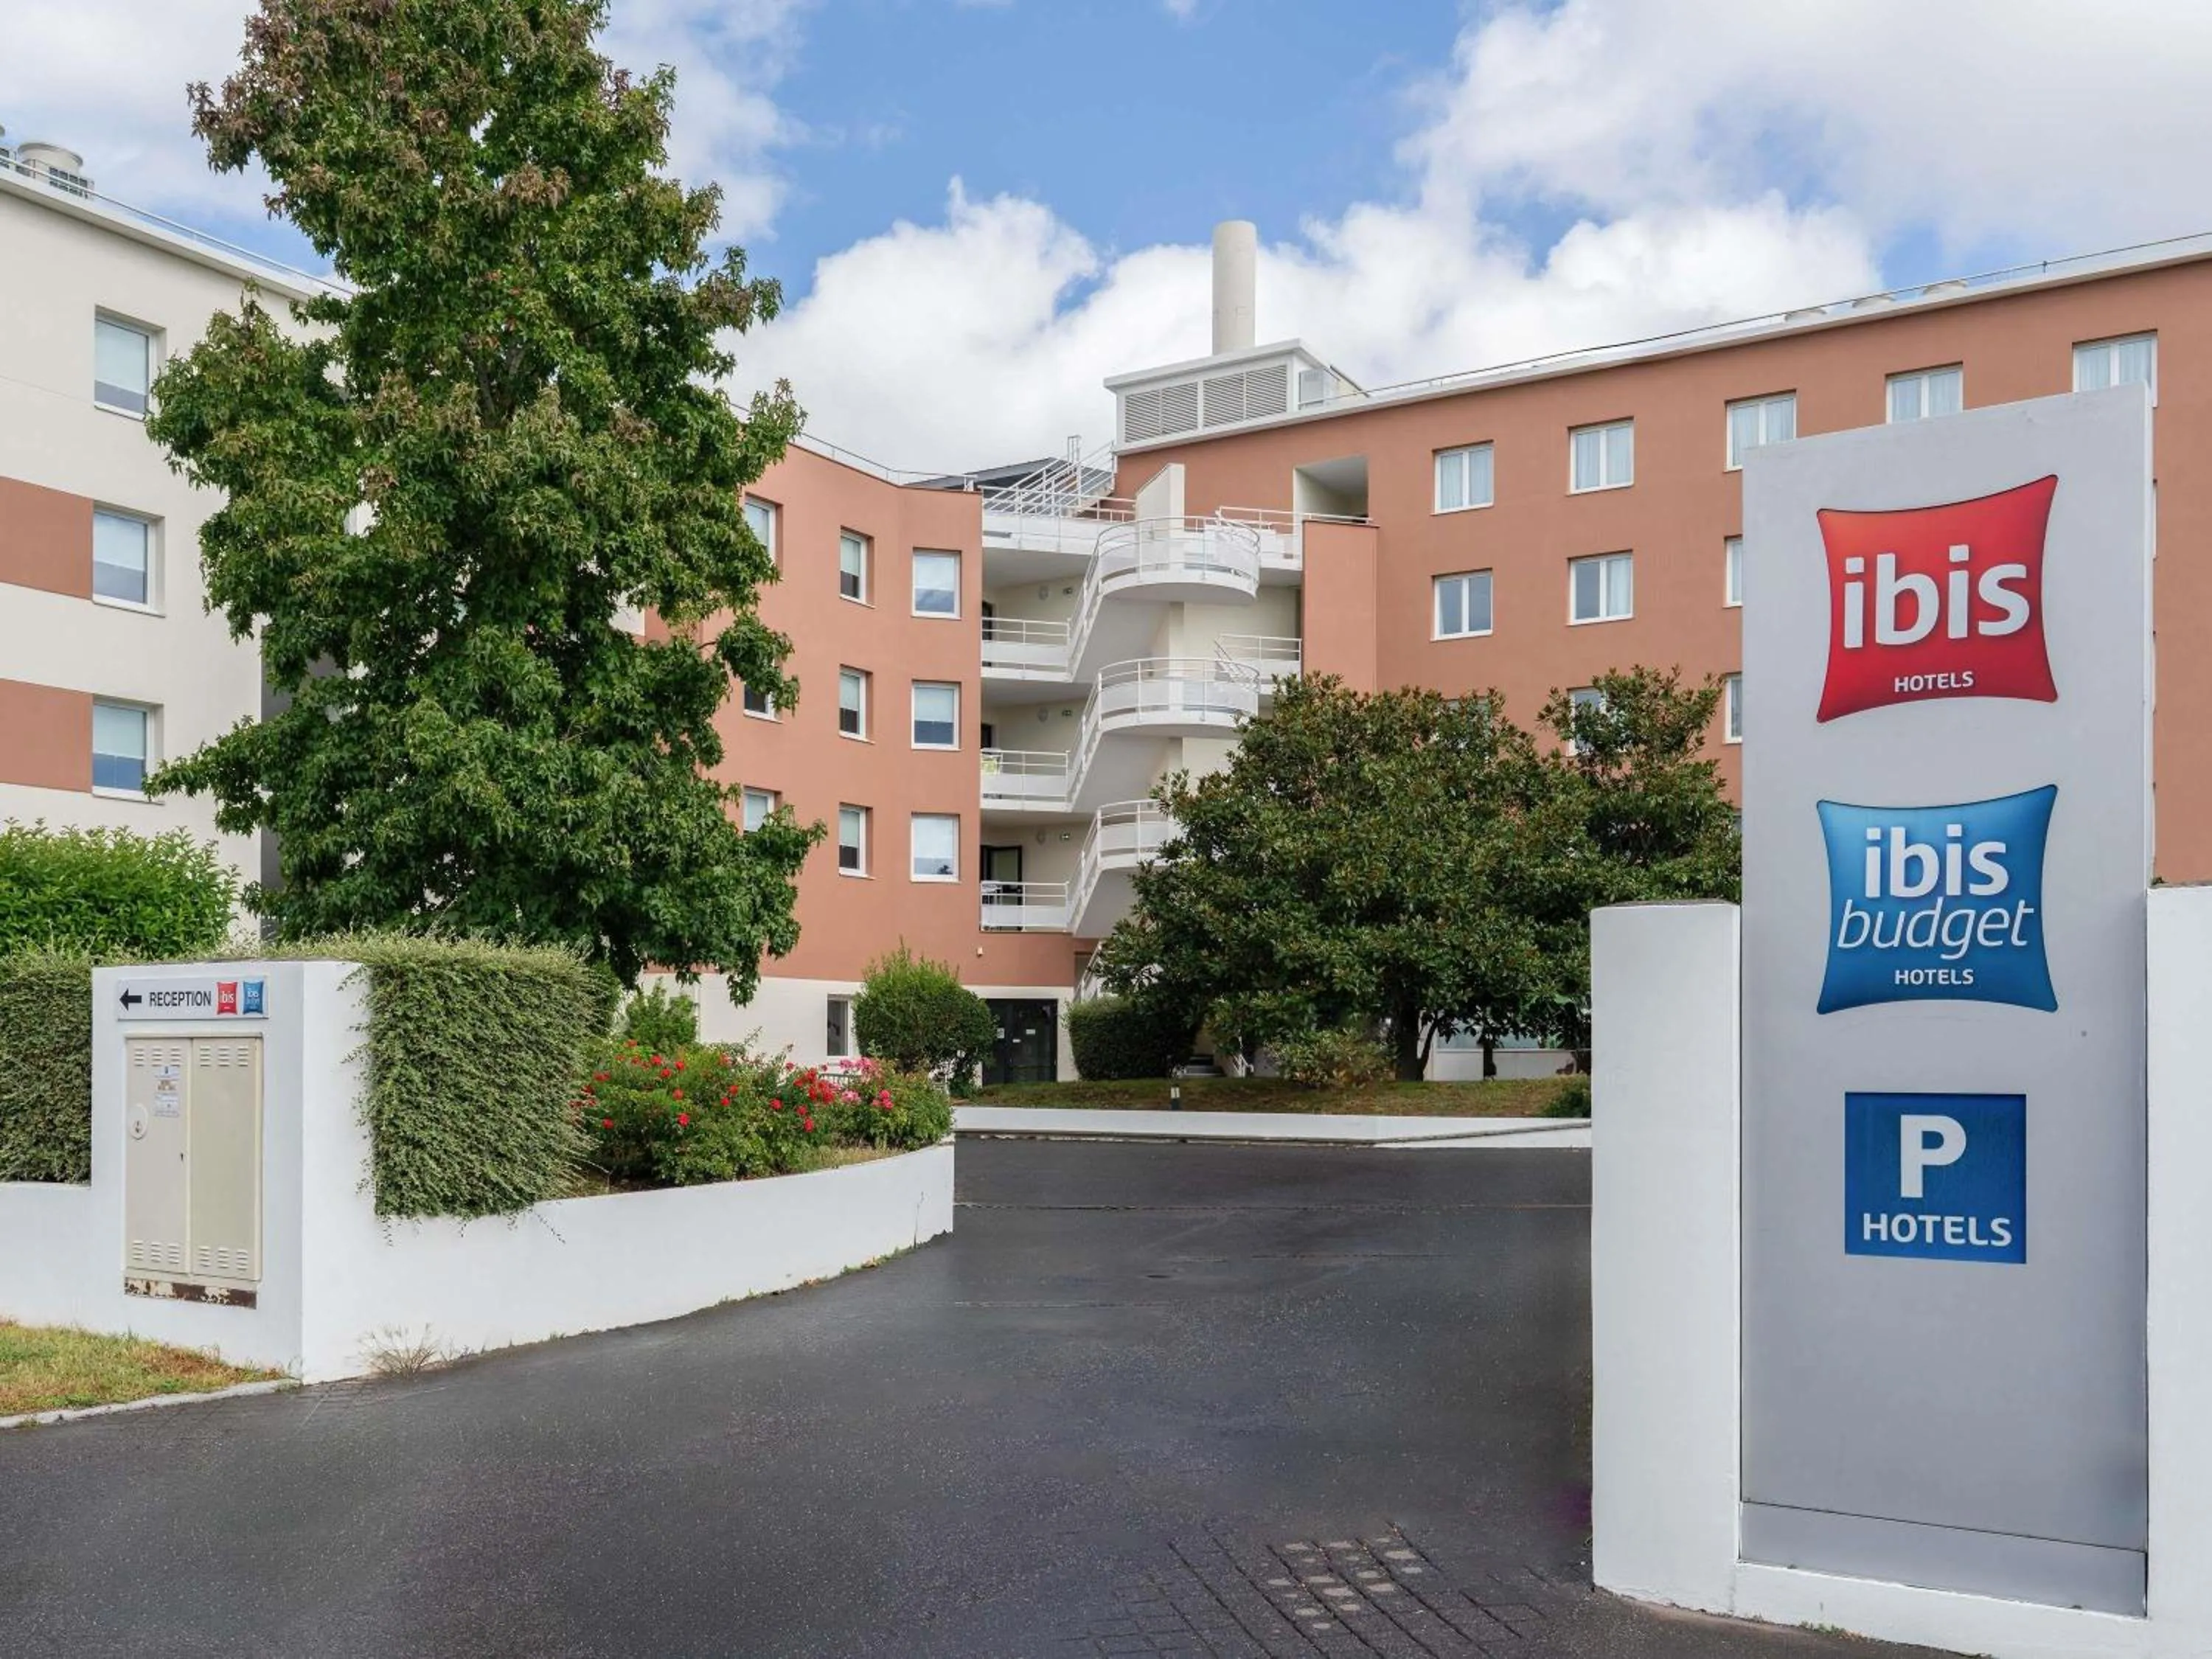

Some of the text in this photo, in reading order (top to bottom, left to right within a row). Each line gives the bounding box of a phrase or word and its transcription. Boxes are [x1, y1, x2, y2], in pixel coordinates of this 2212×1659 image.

[1843, 544, 2031, 649] ibis
[1894, 670, 1975, 692] HOTELS
[1865, 824, 2009, 898] ibis
[1837, 896, 2034, 959] budget
[149, 991, 212, 1006] RECEPTION
[1894, 968, 1975, 986] HOTELS
[1900, 1114, 1967, 1198] P
[1863, 1213, 2012, 1247] HOTELS
